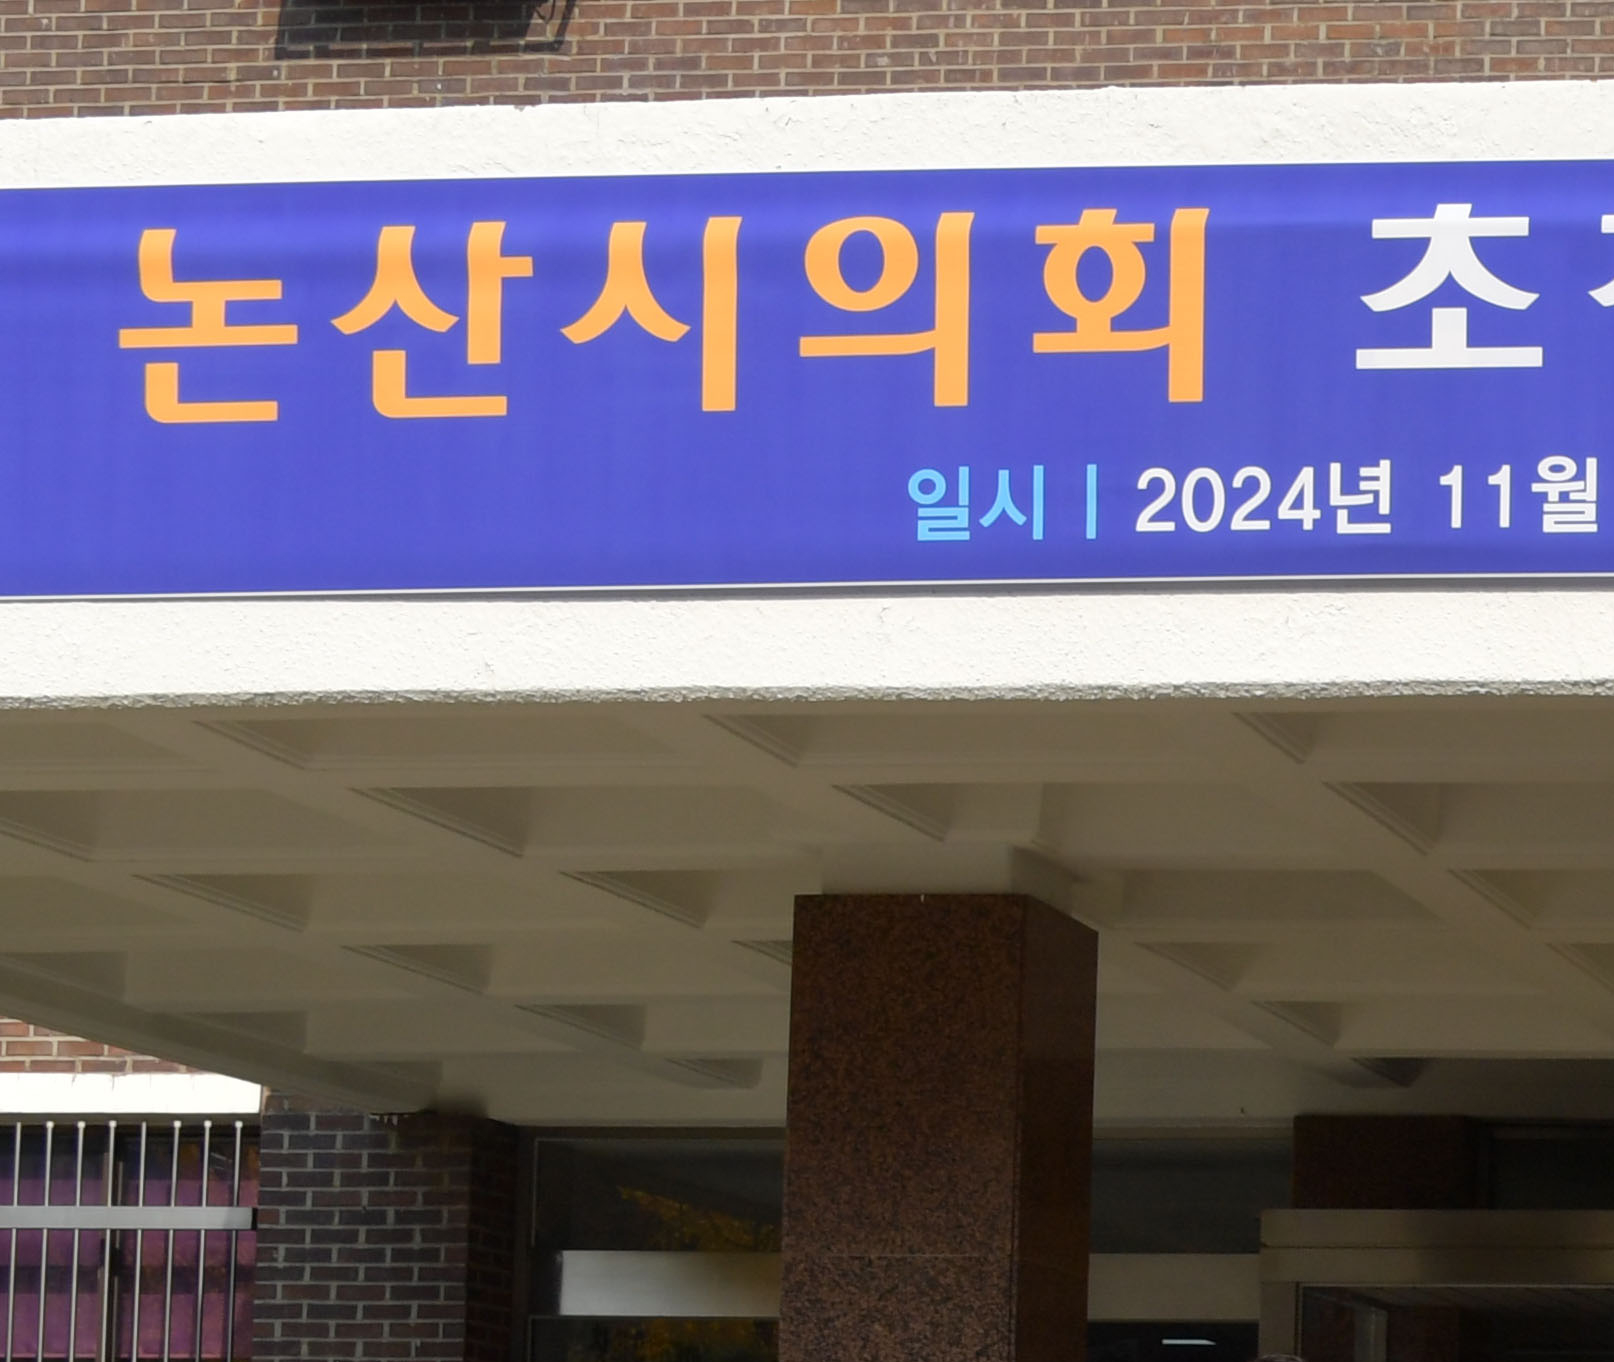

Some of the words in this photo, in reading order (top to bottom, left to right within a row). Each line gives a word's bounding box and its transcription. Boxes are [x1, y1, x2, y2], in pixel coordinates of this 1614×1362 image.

[118, 205, 1211, 424] 논산시의회
[907, 464, 1045, 542] 일시
[1134, 458, 1392, 535] 2024년
[1439, 455, 1599, 534] 11월
